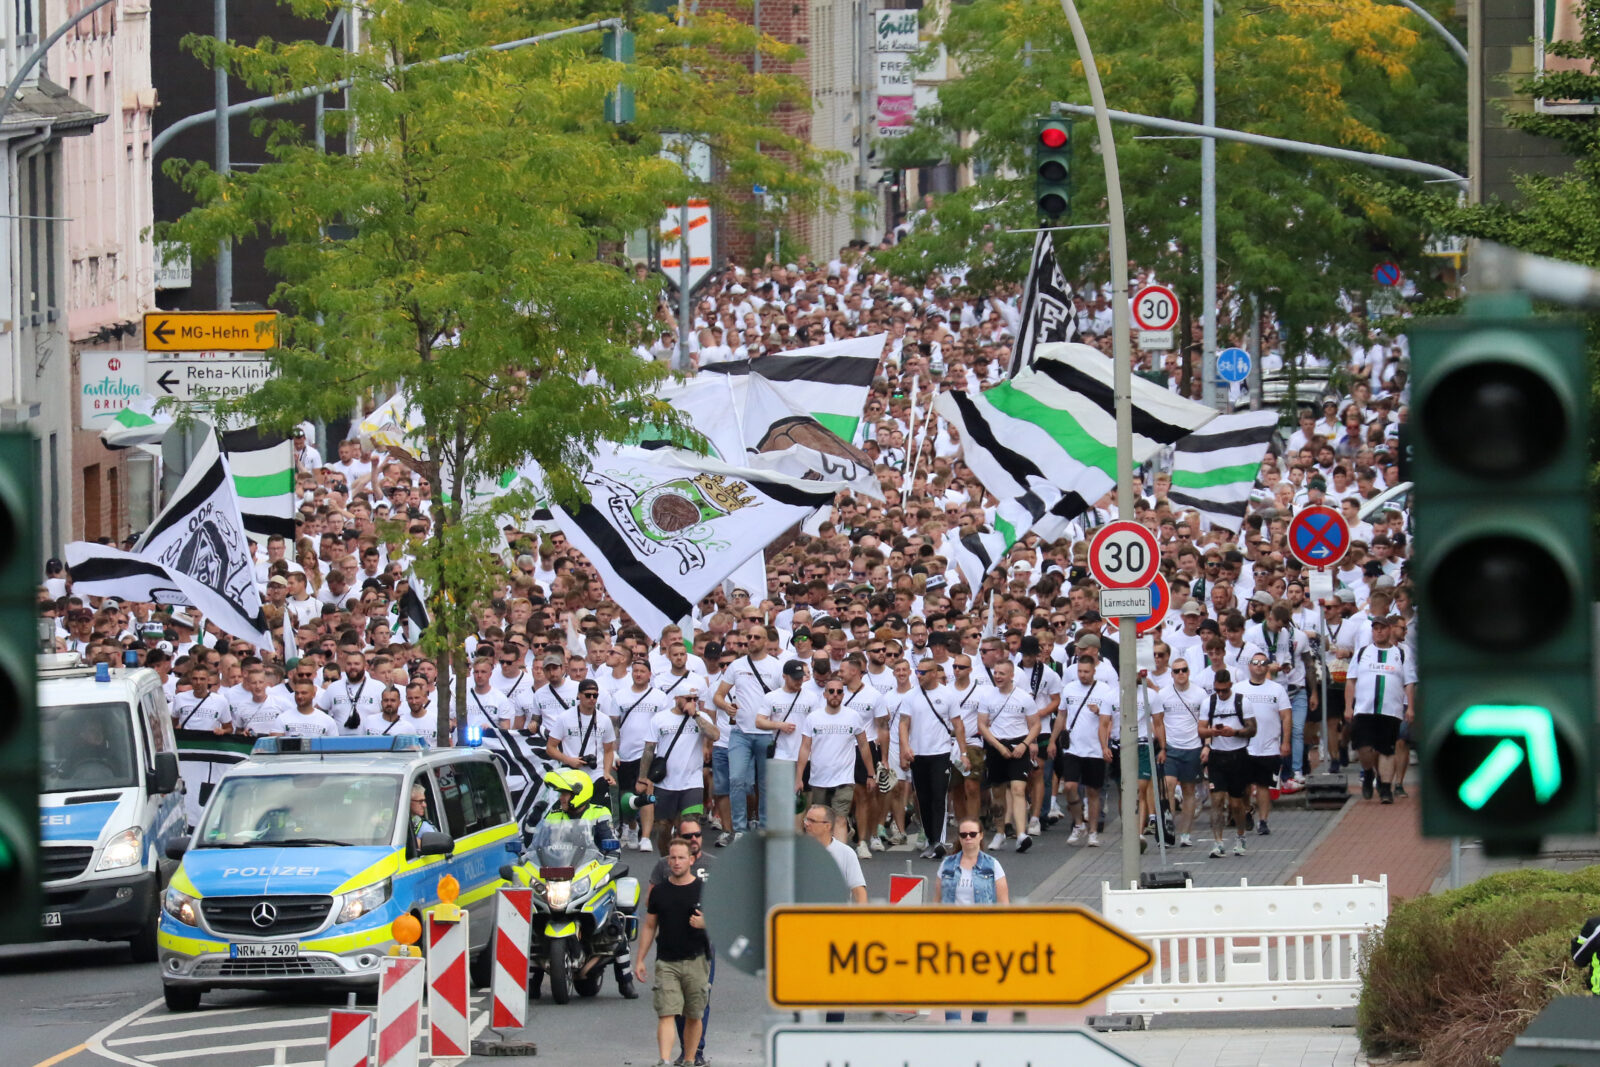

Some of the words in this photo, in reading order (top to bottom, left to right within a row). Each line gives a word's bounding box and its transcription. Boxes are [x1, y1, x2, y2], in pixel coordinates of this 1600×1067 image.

[881, 75, 909, 85] TIME
[1142, 299, 1169, 320] 30
[181, 326, 250, 339] MG-Hehn
[187, 366, 273, 380] Reha-Klinik
[83, 375, 142, 401] antalya
[1105, 541, 1144, 573] 30
[1104, 598, 1146, 608] Lärmschutz
[222, 866, 321, 878] POLIZEI
[236, 945, 255, 957] NRW
[260, 944, 297, 956] 4-2499
[827, 941, 1056, 985] MG-Rheydt
